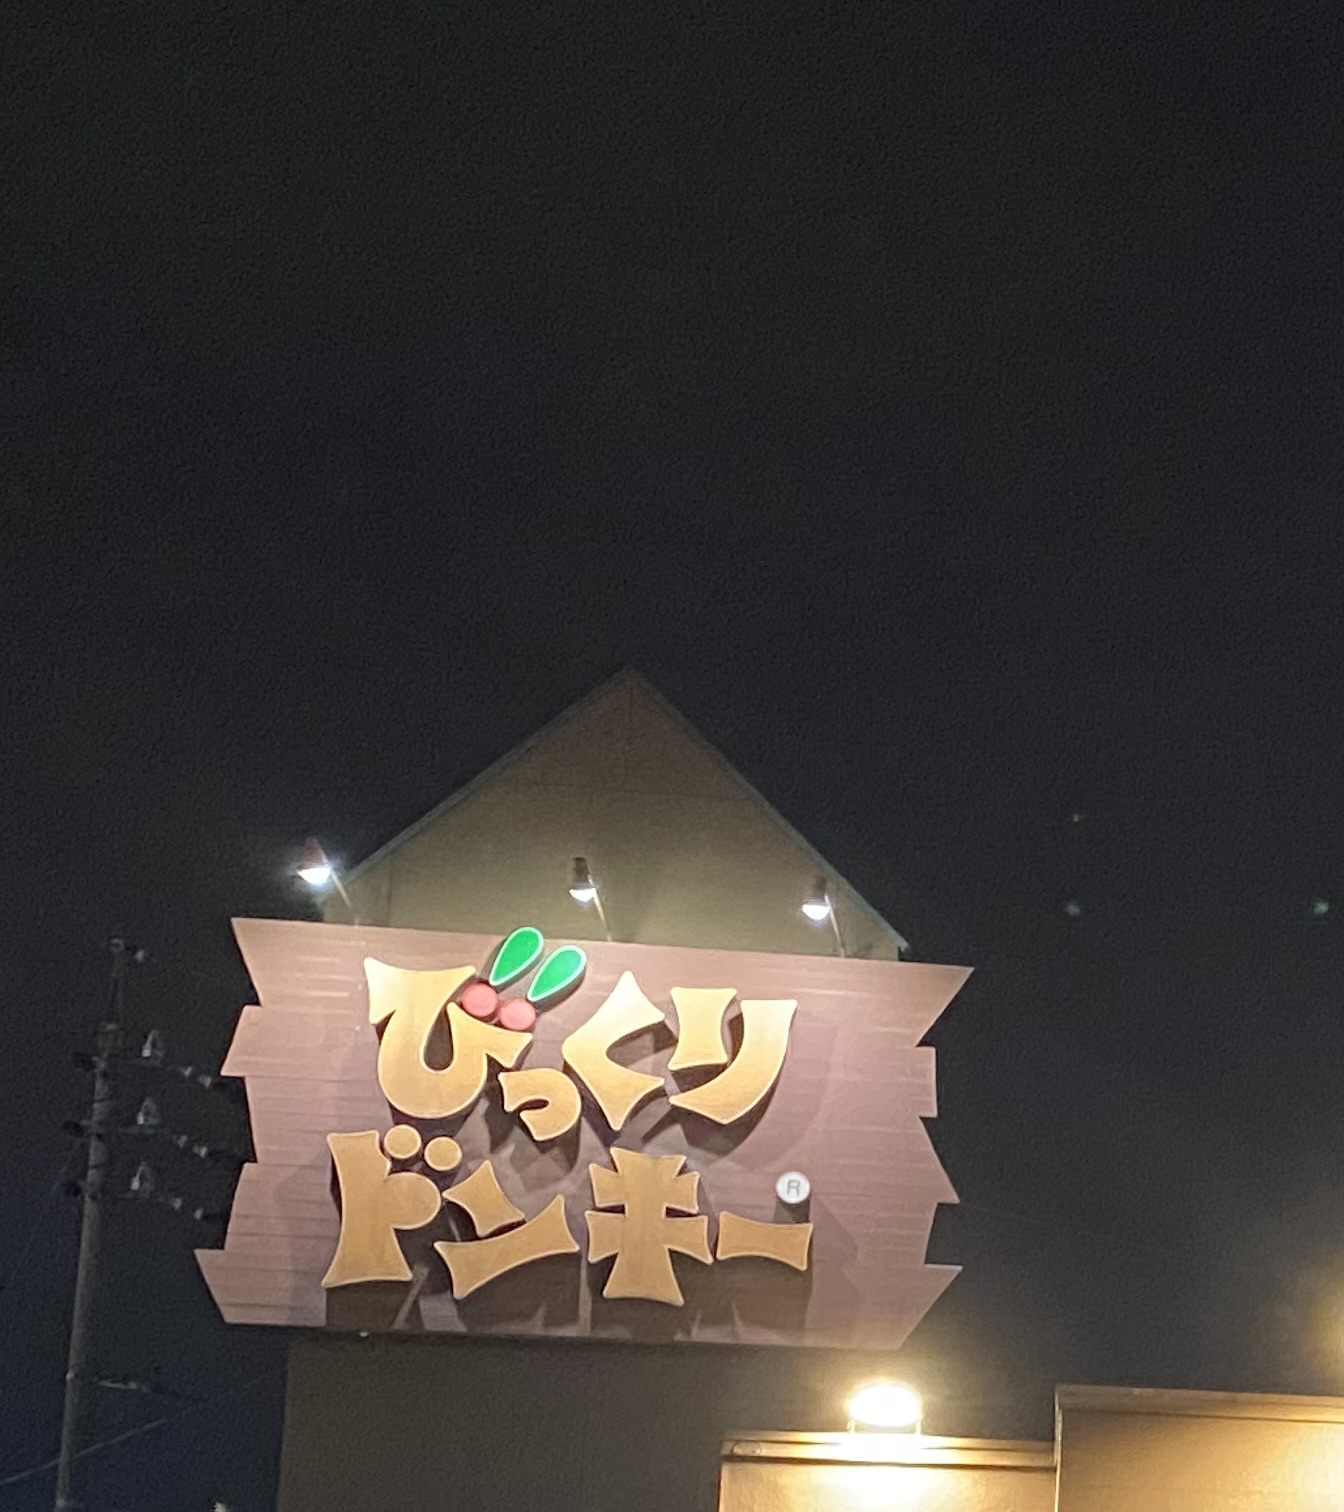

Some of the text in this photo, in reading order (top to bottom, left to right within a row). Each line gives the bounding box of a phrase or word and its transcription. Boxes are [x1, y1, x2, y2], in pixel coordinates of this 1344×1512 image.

[364, 957, 798, 1141] びっくり
[321, 1124, 814, 1306] ドンキー
